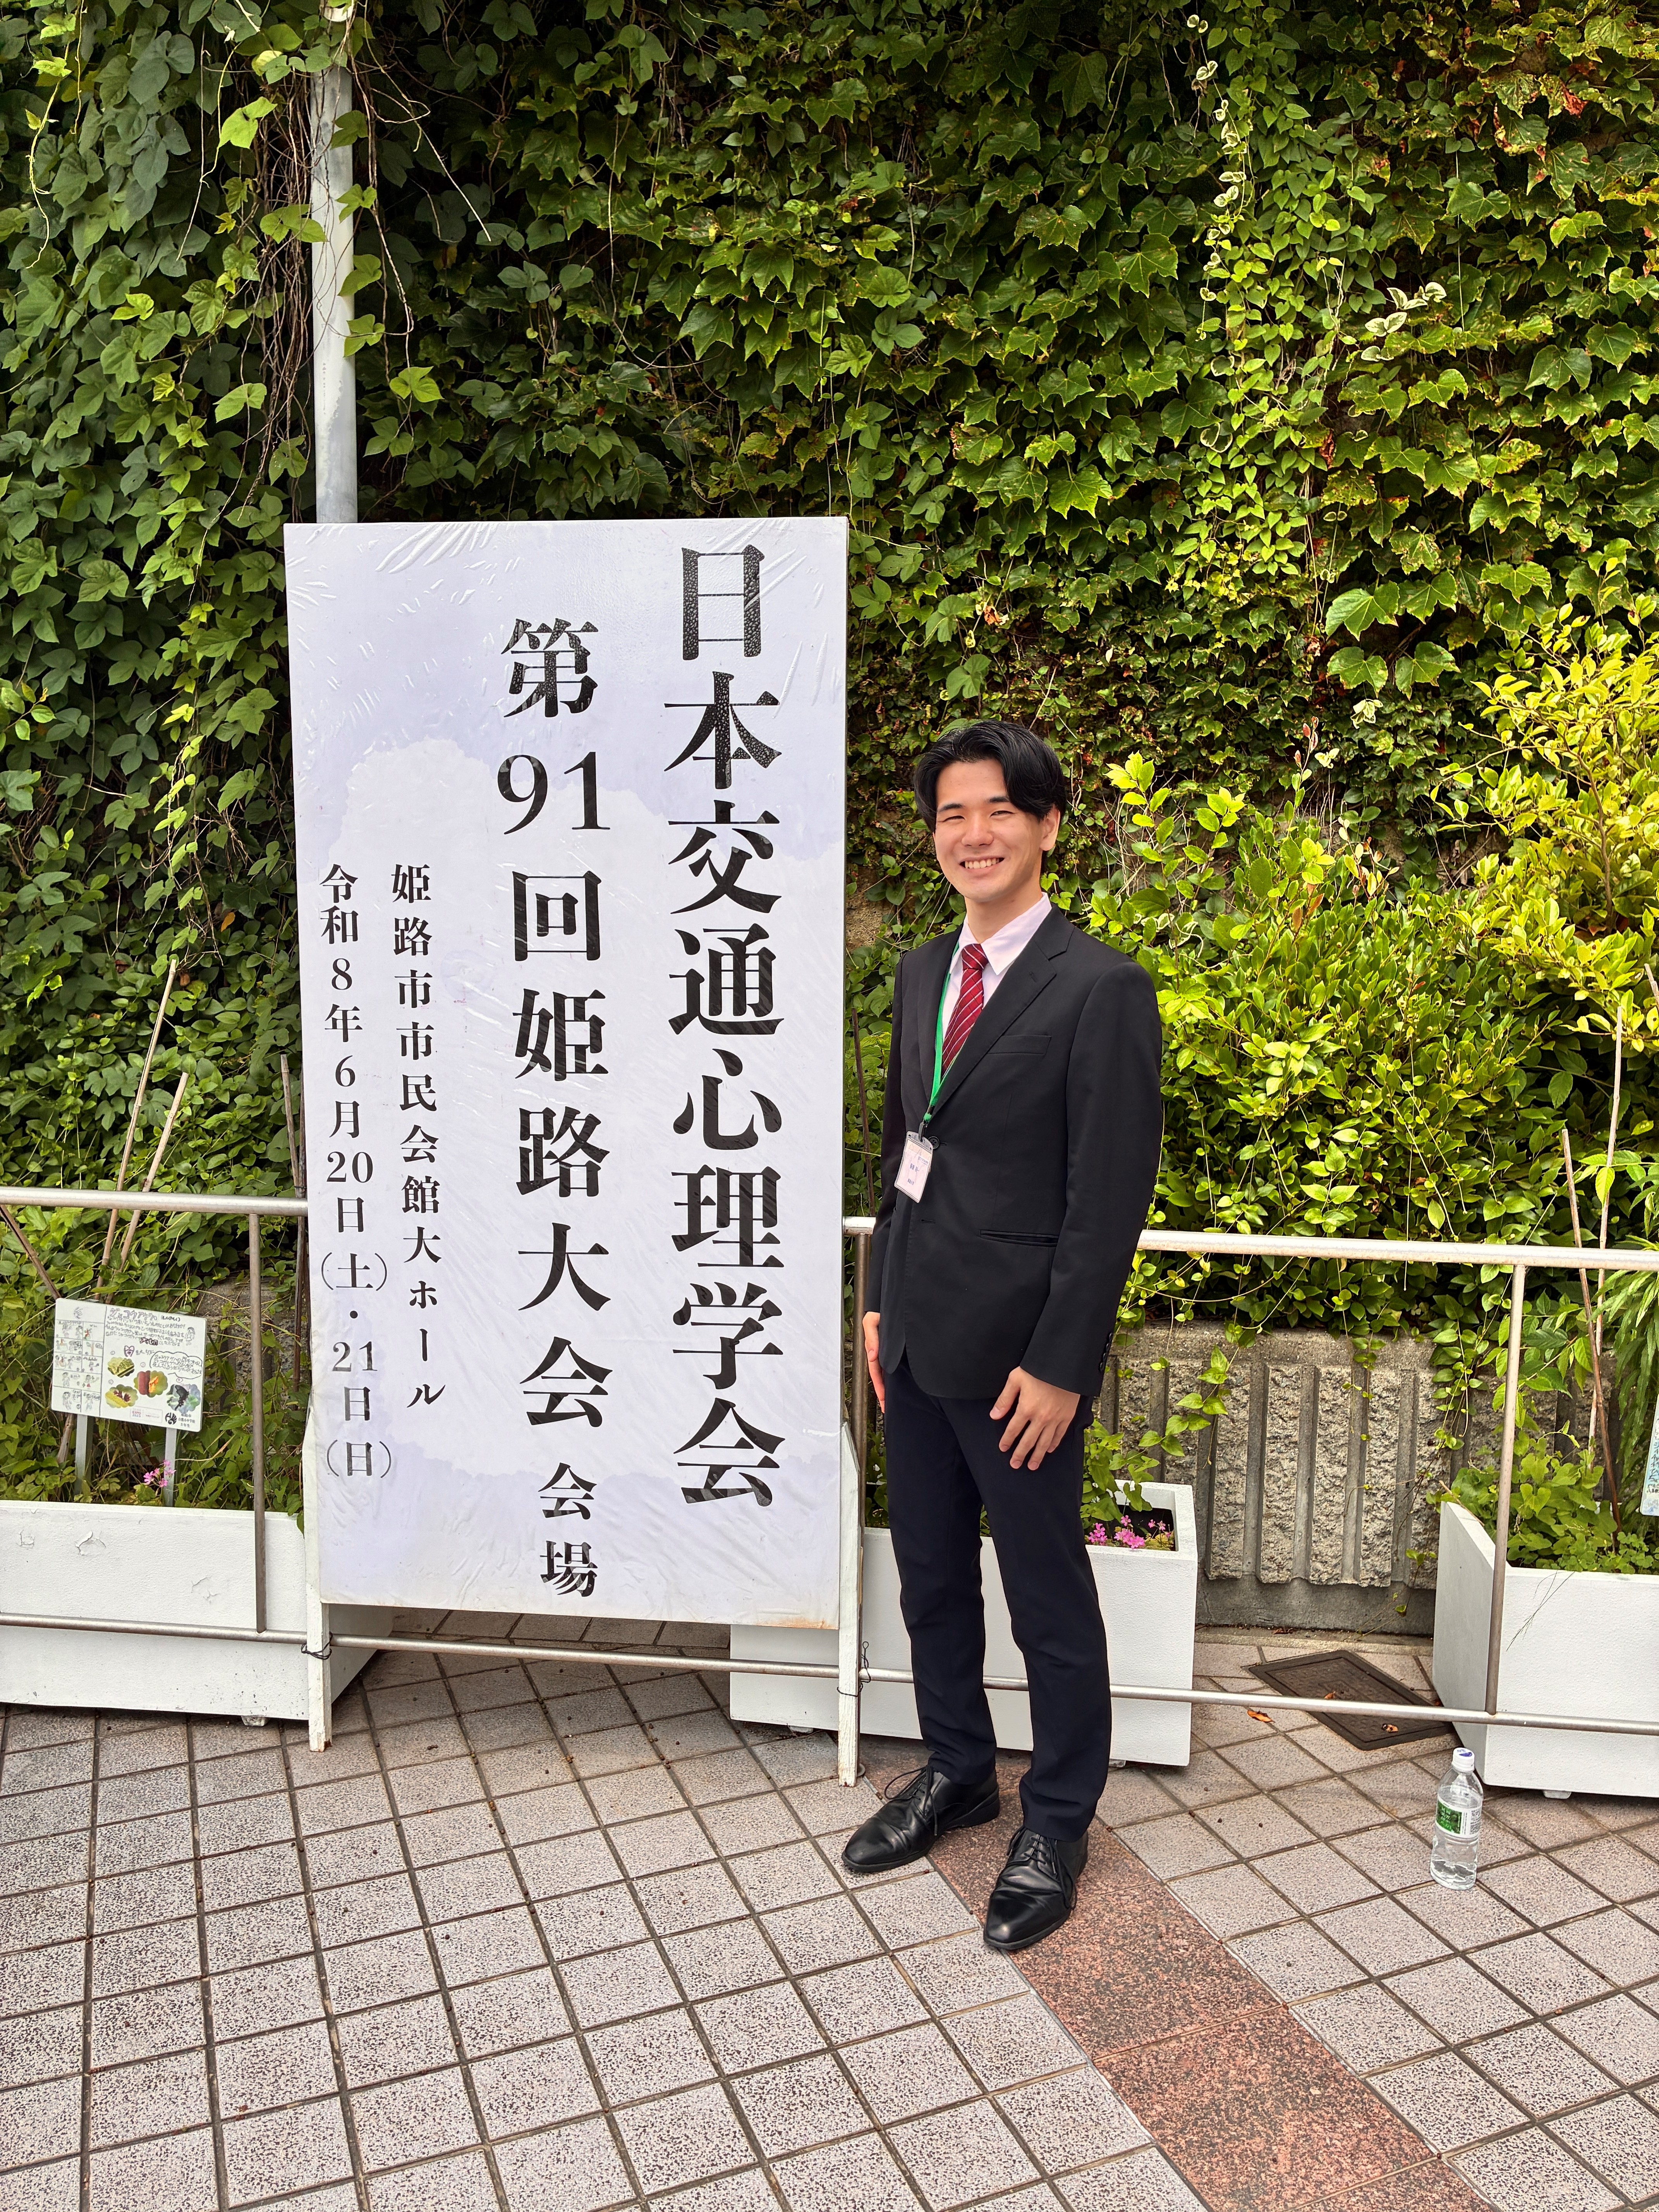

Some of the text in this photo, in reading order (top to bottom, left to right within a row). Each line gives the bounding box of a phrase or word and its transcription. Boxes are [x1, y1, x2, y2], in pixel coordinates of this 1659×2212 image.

[391, 864, 446, 1408] 姫路市市民会館大ホール
[497, 617, 613, 1597] 第91回姫路大会 会場
[664, 544, 785, 1507] 日本交通心理学会
